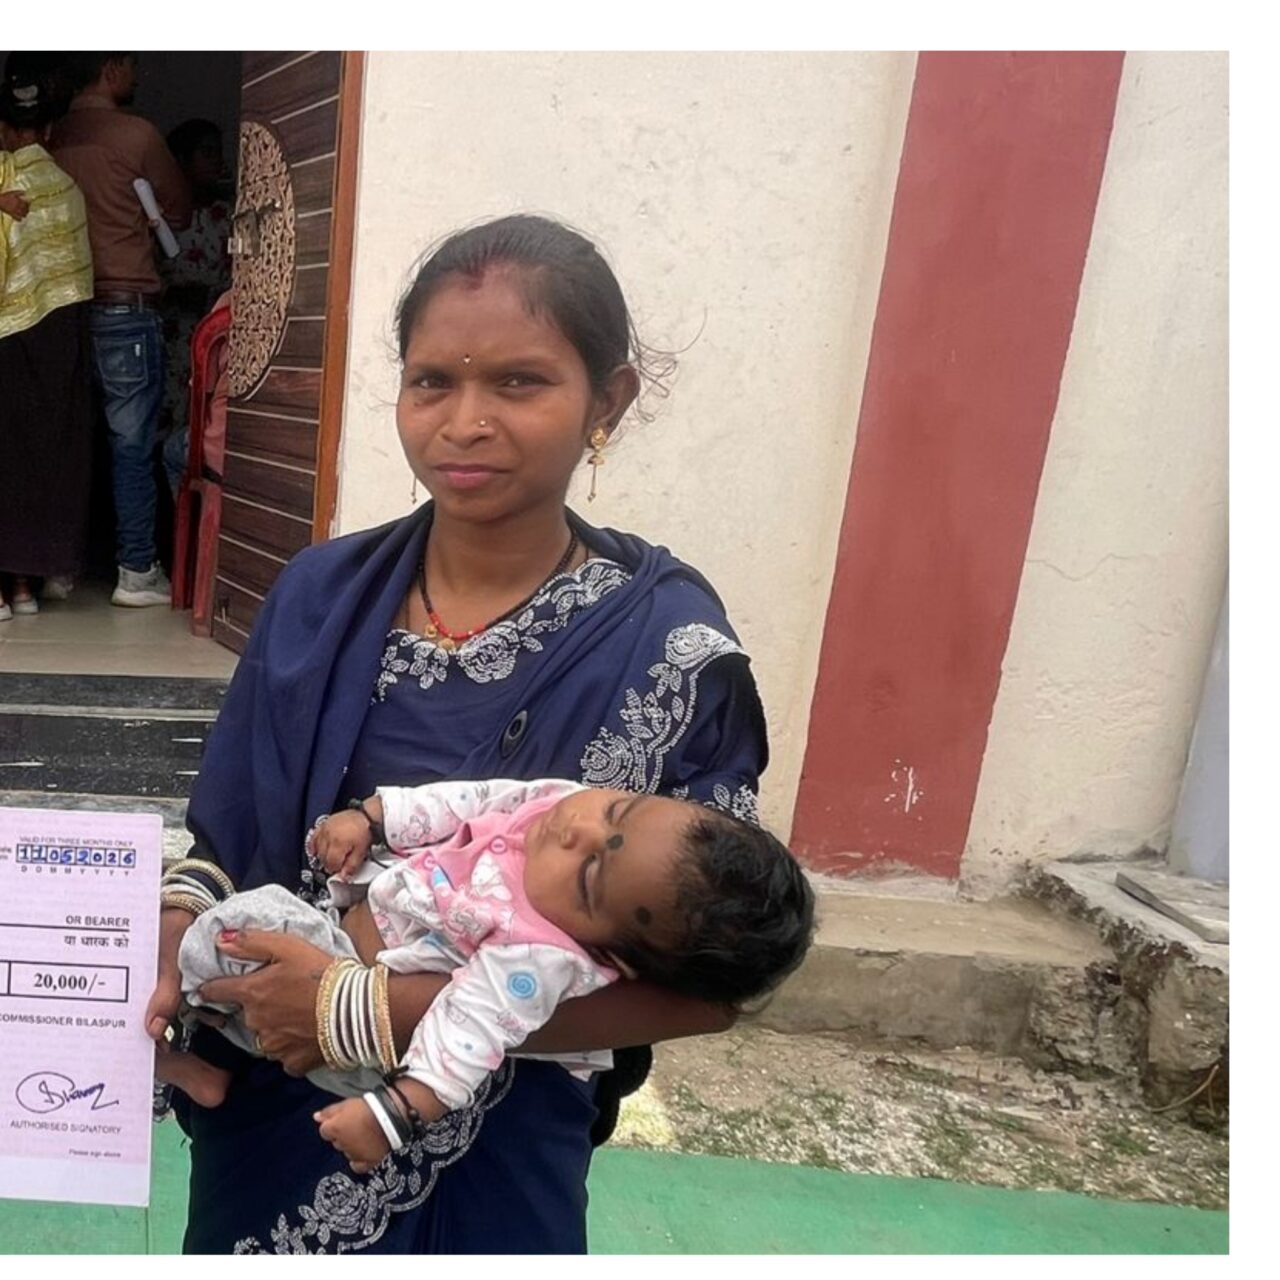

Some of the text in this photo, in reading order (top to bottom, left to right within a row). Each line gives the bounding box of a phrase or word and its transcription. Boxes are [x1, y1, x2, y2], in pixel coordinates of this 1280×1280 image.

[66, 915, 130, 927] OR BEARER
[33, 973, 106, 995] 20,000/-
[76, 1018, 126, 1028] BILASPUR
[10, 1120, 121, 1134] AUTHORISED SIGNATORY
